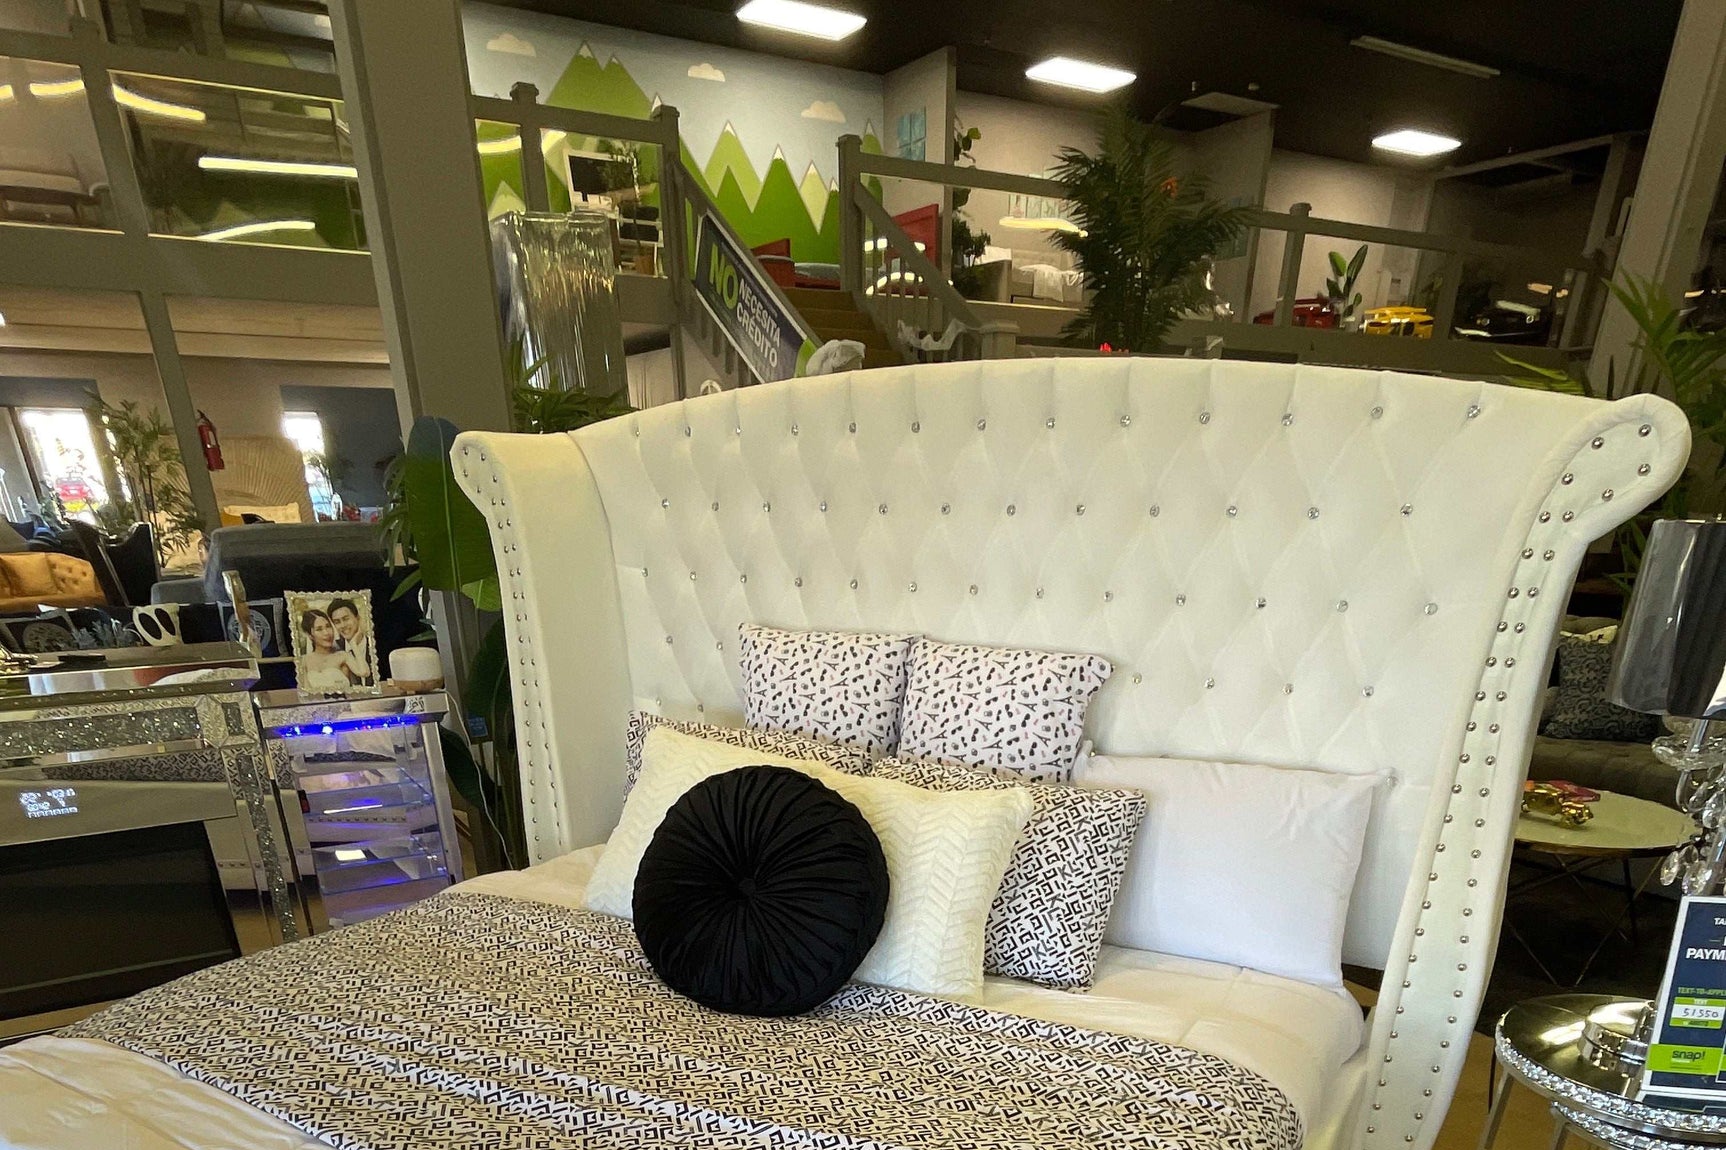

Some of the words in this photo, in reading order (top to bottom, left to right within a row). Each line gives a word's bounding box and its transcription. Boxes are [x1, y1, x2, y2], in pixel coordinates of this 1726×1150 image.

[709, 242, 739, 310] NO
[736, 302, 778, 368] CRÉDITO
[739, 278, 781, 348] NECESITA
[1686, 947, 1726, 961] PAYM
[1671, 1050, 1706, 1062] snap!
